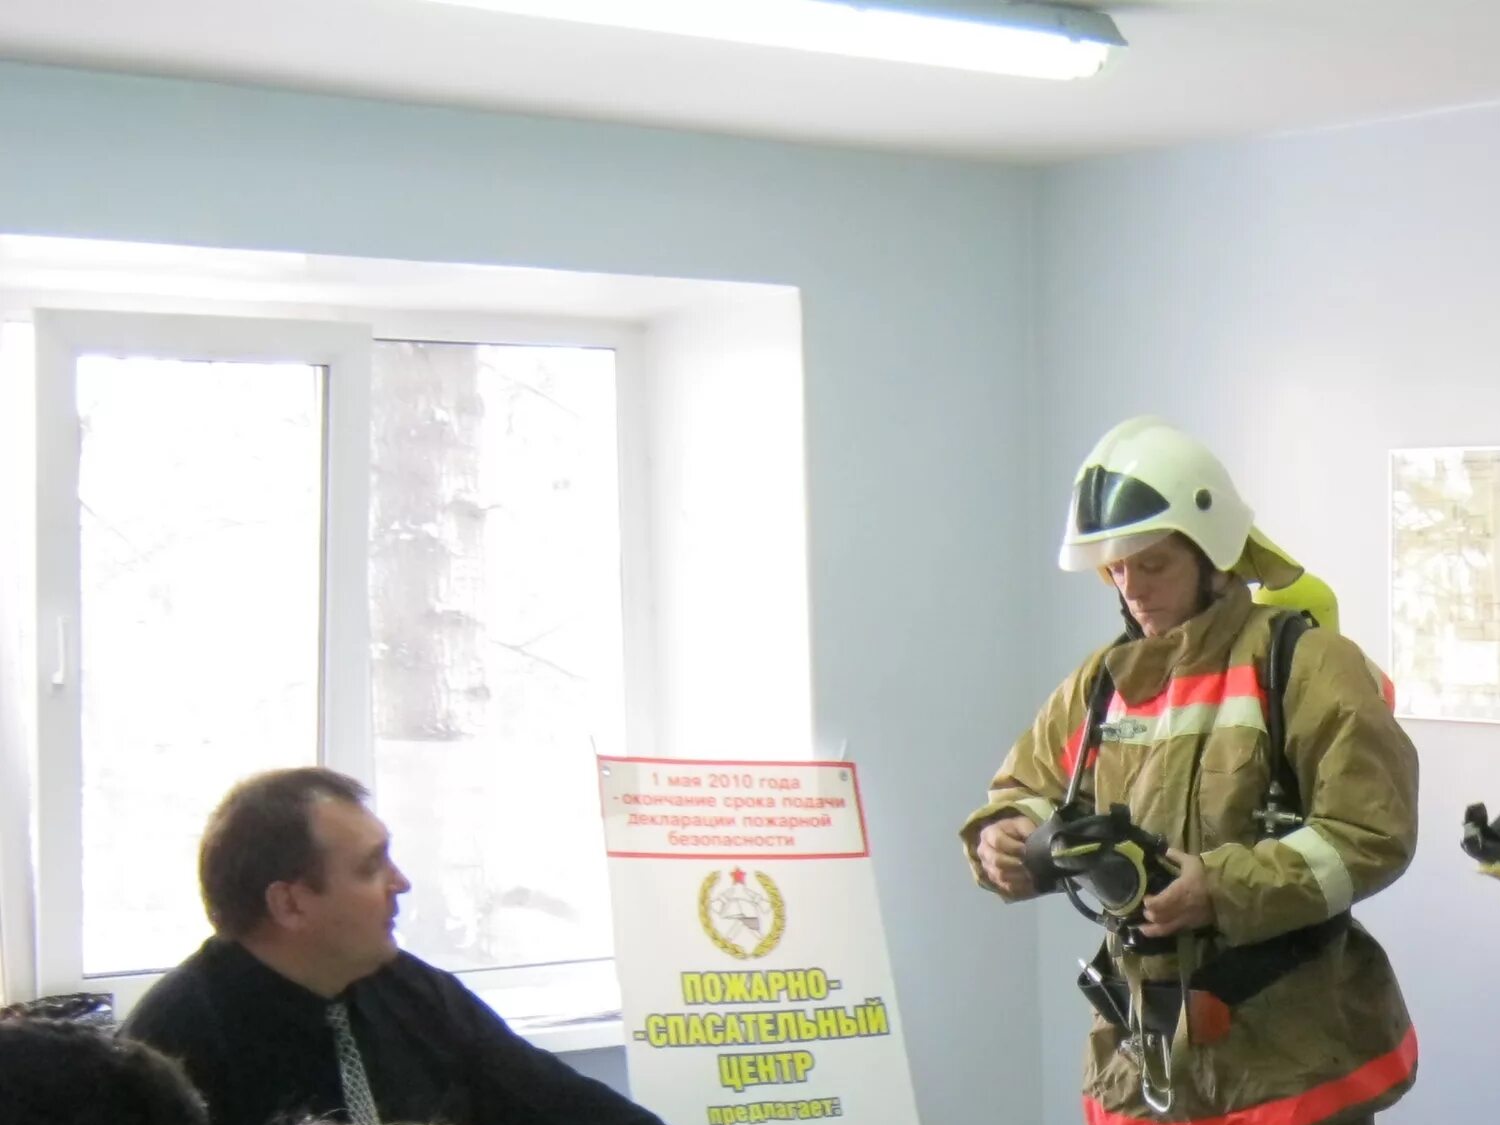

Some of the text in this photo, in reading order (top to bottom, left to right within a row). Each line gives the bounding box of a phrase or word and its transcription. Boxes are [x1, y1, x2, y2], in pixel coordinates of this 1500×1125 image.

[652, 773, 802, 790] 1 мая 2010 года
[723, 794, 776, 810] срока
[782, 795, 847, 810] подачи
[626, 811, 833, 829] декларации пожарной
[667, 829, 795, 847] безопасности
[681, 967, 842, 1005] ПОЖАРНО-
[633, 996, 890, 1048] -СПАСАТЕЛЬНЫЙ
[717, 1050, 815, 1092] ЦЕНТР
